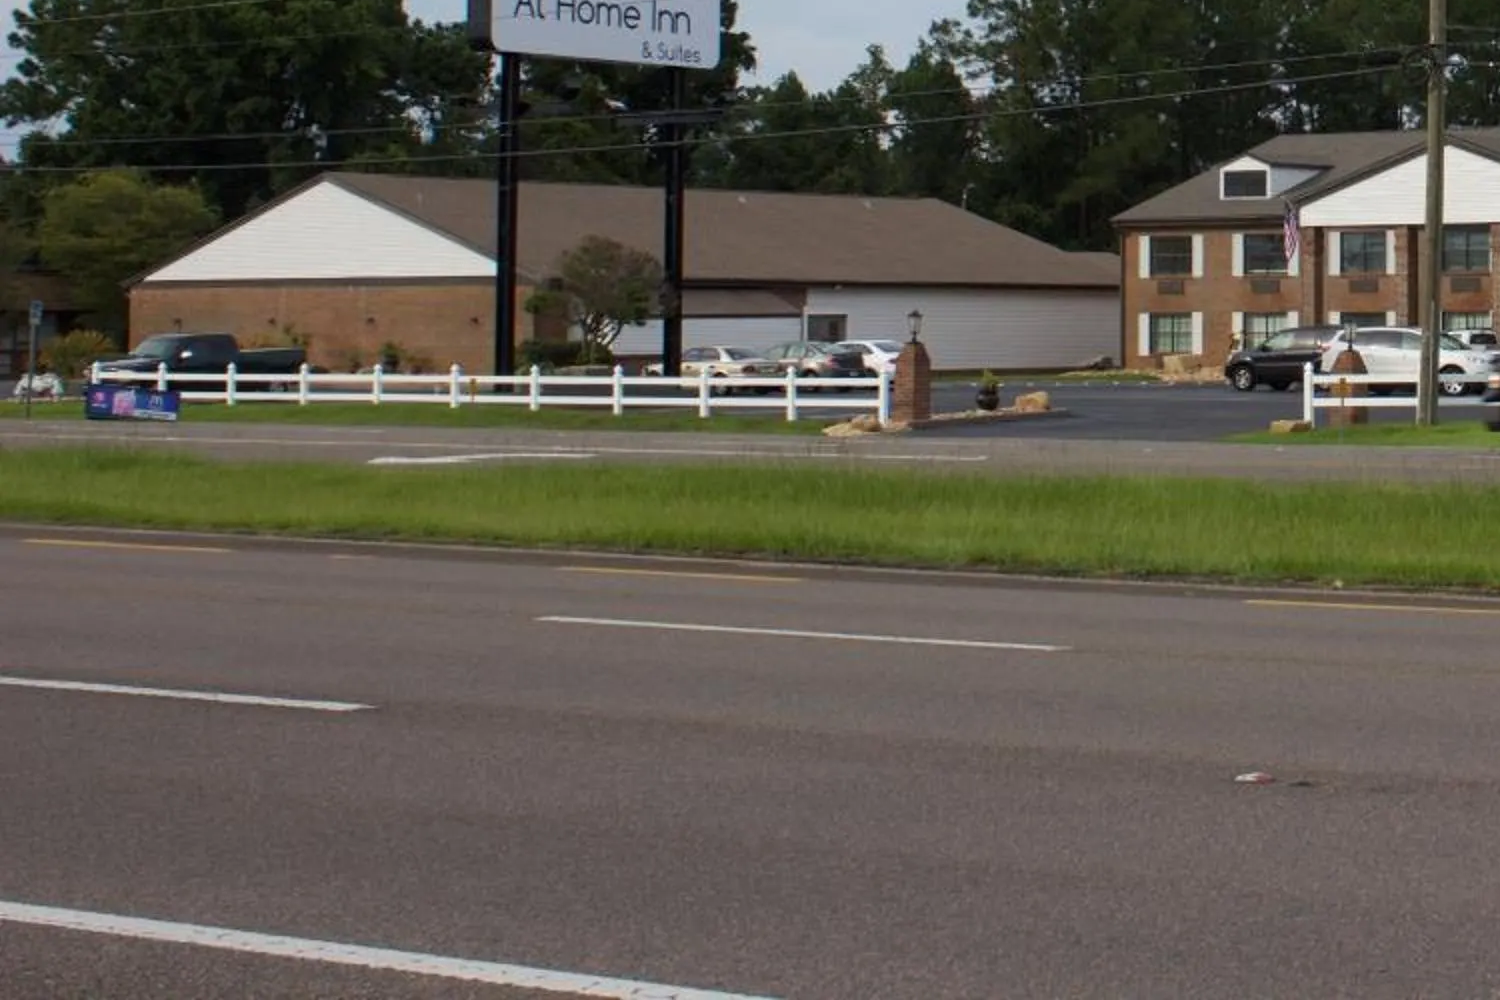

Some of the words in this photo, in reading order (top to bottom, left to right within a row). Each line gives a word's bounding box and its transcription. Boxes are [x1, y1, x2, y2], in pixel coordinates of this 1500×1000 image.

[651, 0, 691, 34] Inn
[641, 41, 654, 60] &
[657, 42, 701, 63] Suites
